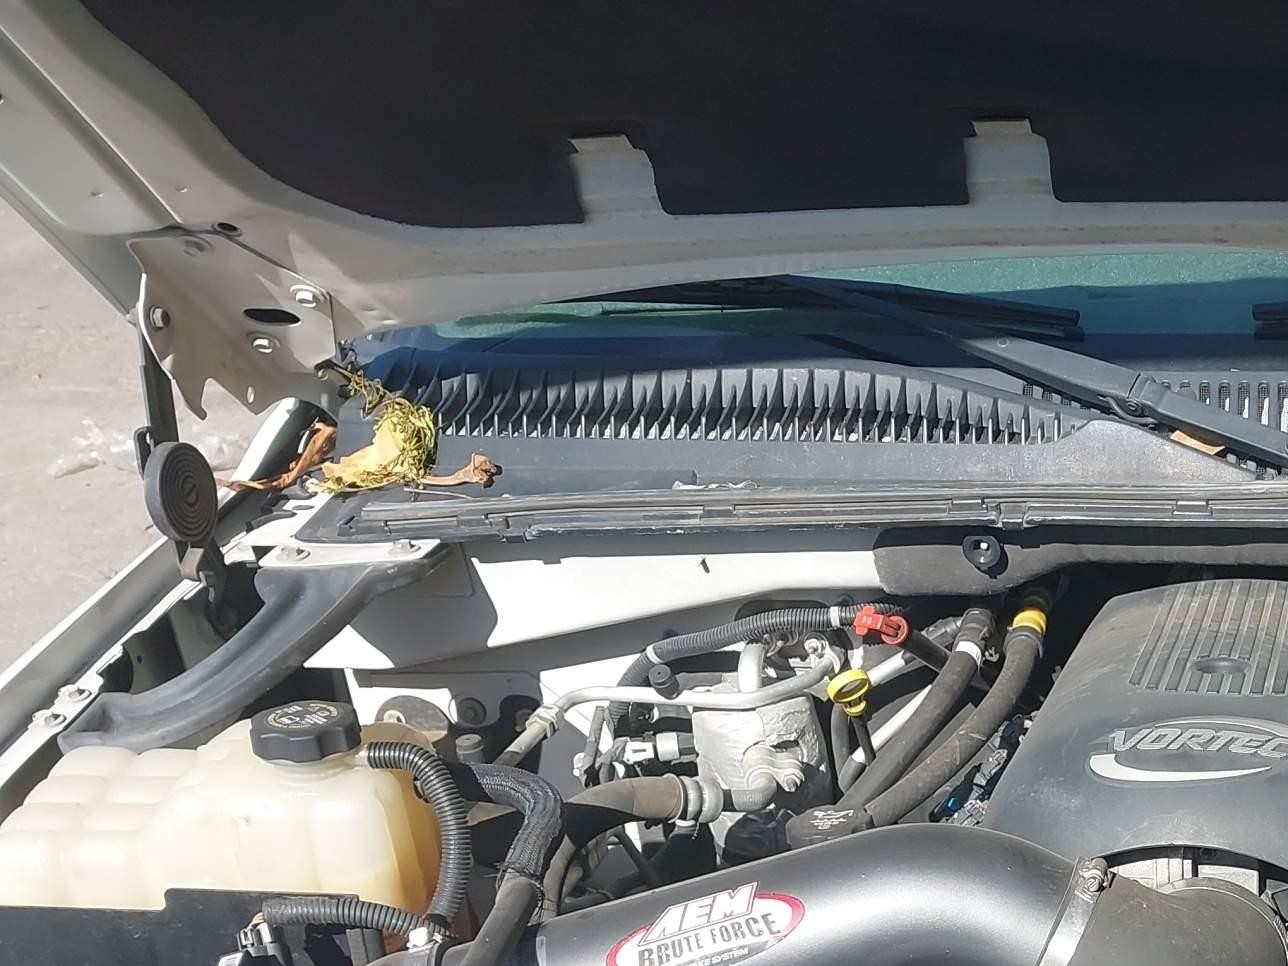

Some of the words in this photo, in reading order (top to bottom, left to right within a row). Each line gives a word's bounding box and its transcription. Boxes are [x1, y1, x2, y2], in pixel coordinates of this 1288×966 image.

[639, 883, 758, 946] AEM
[711, 913, 779, 944] FORCE
[711, 947, 749, 966] SYSTEM
